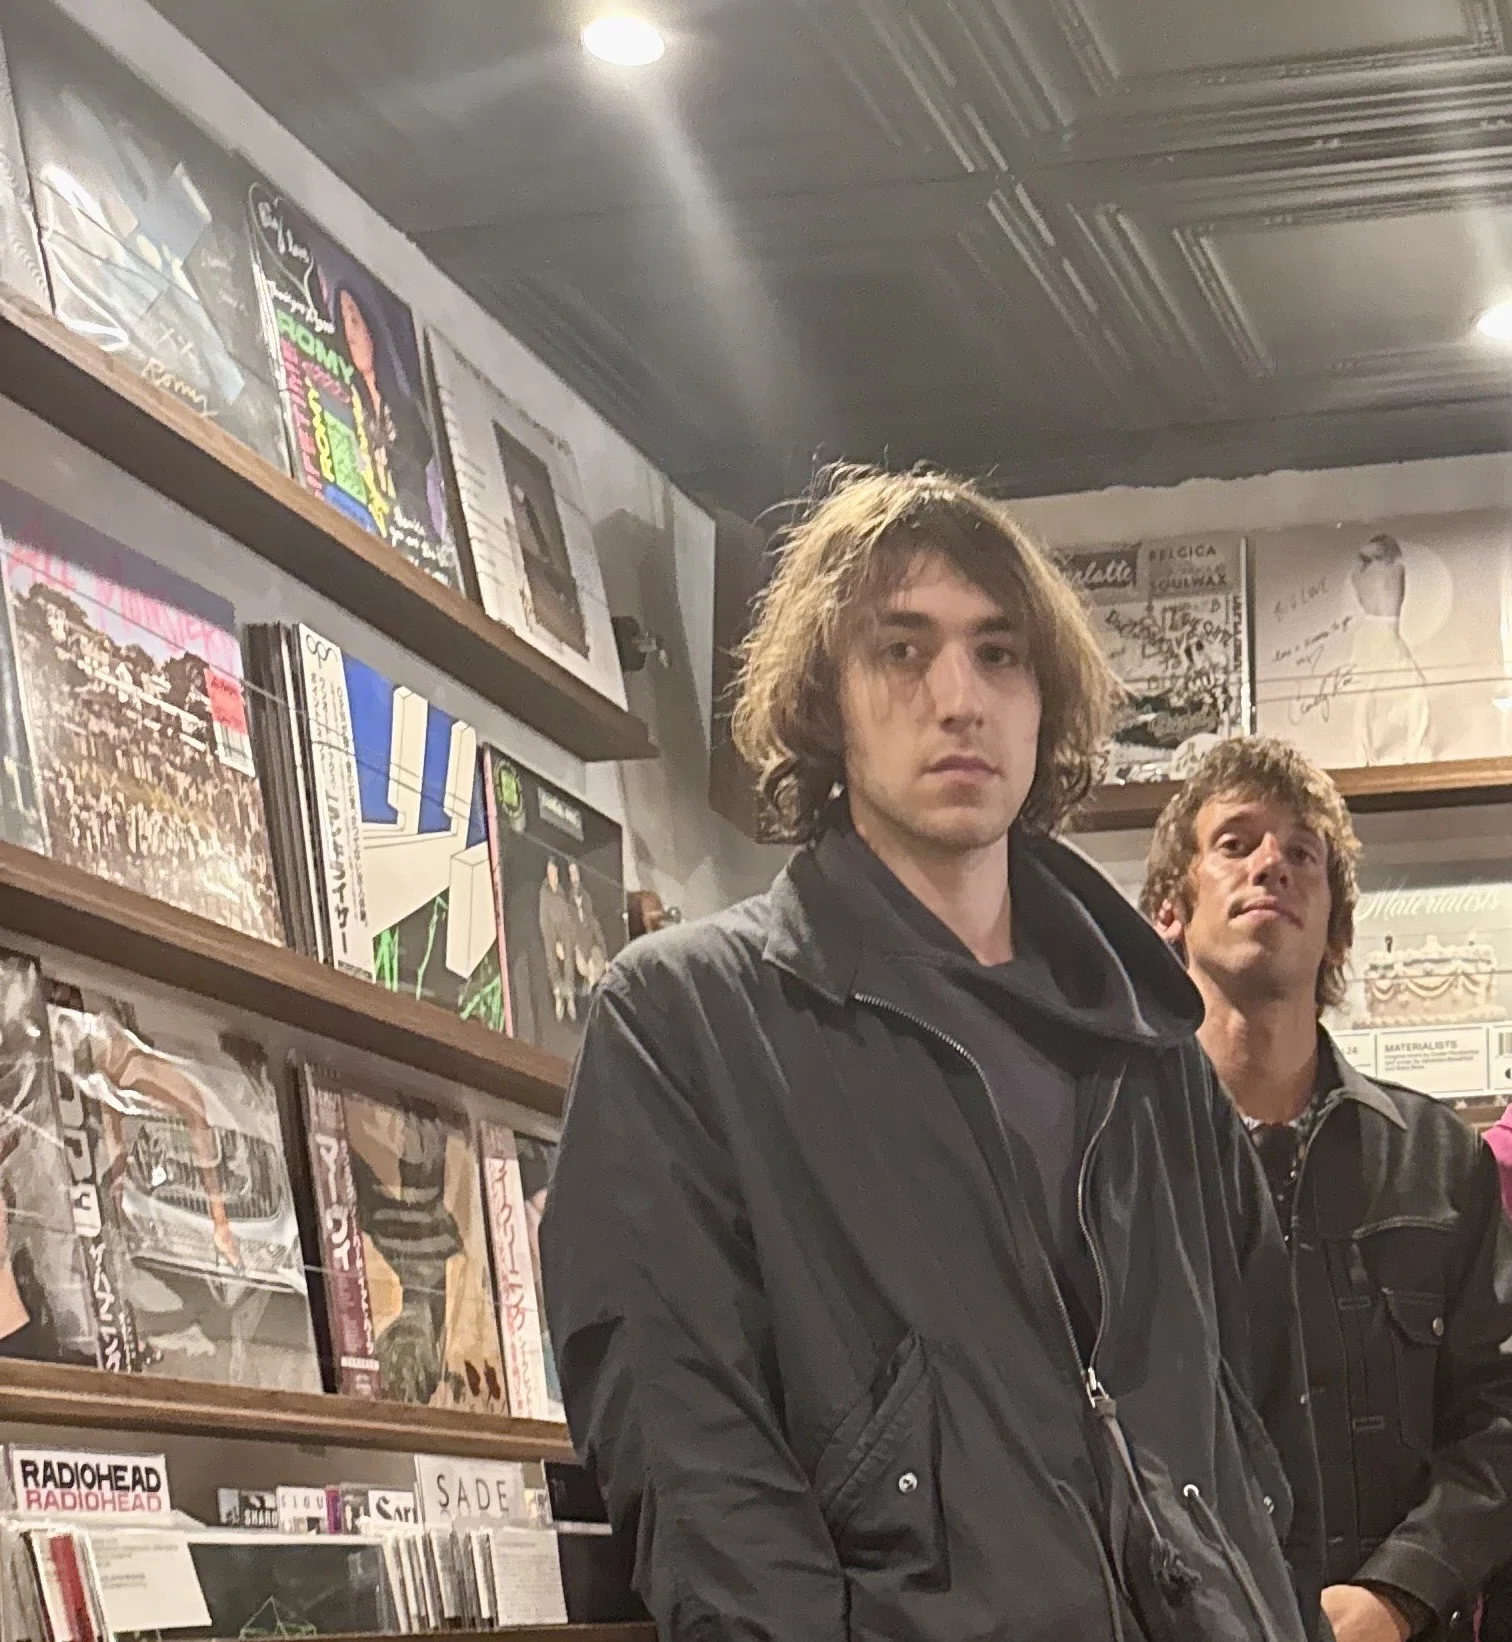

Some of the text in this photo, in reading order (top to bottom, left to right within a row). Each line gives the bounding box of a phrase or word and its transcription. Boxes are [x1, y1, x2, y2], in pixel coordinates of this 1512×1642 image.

[277, 309, 355, 384] ROMY
[1384, 1040, 1458, 1053] MATERIALISTS
[20, 1458, 162, 1493] RADIOHEAD
[436, 1473, 510, 1513] SADE
[25, 1488, 163, 1513] RADIOHEAD
